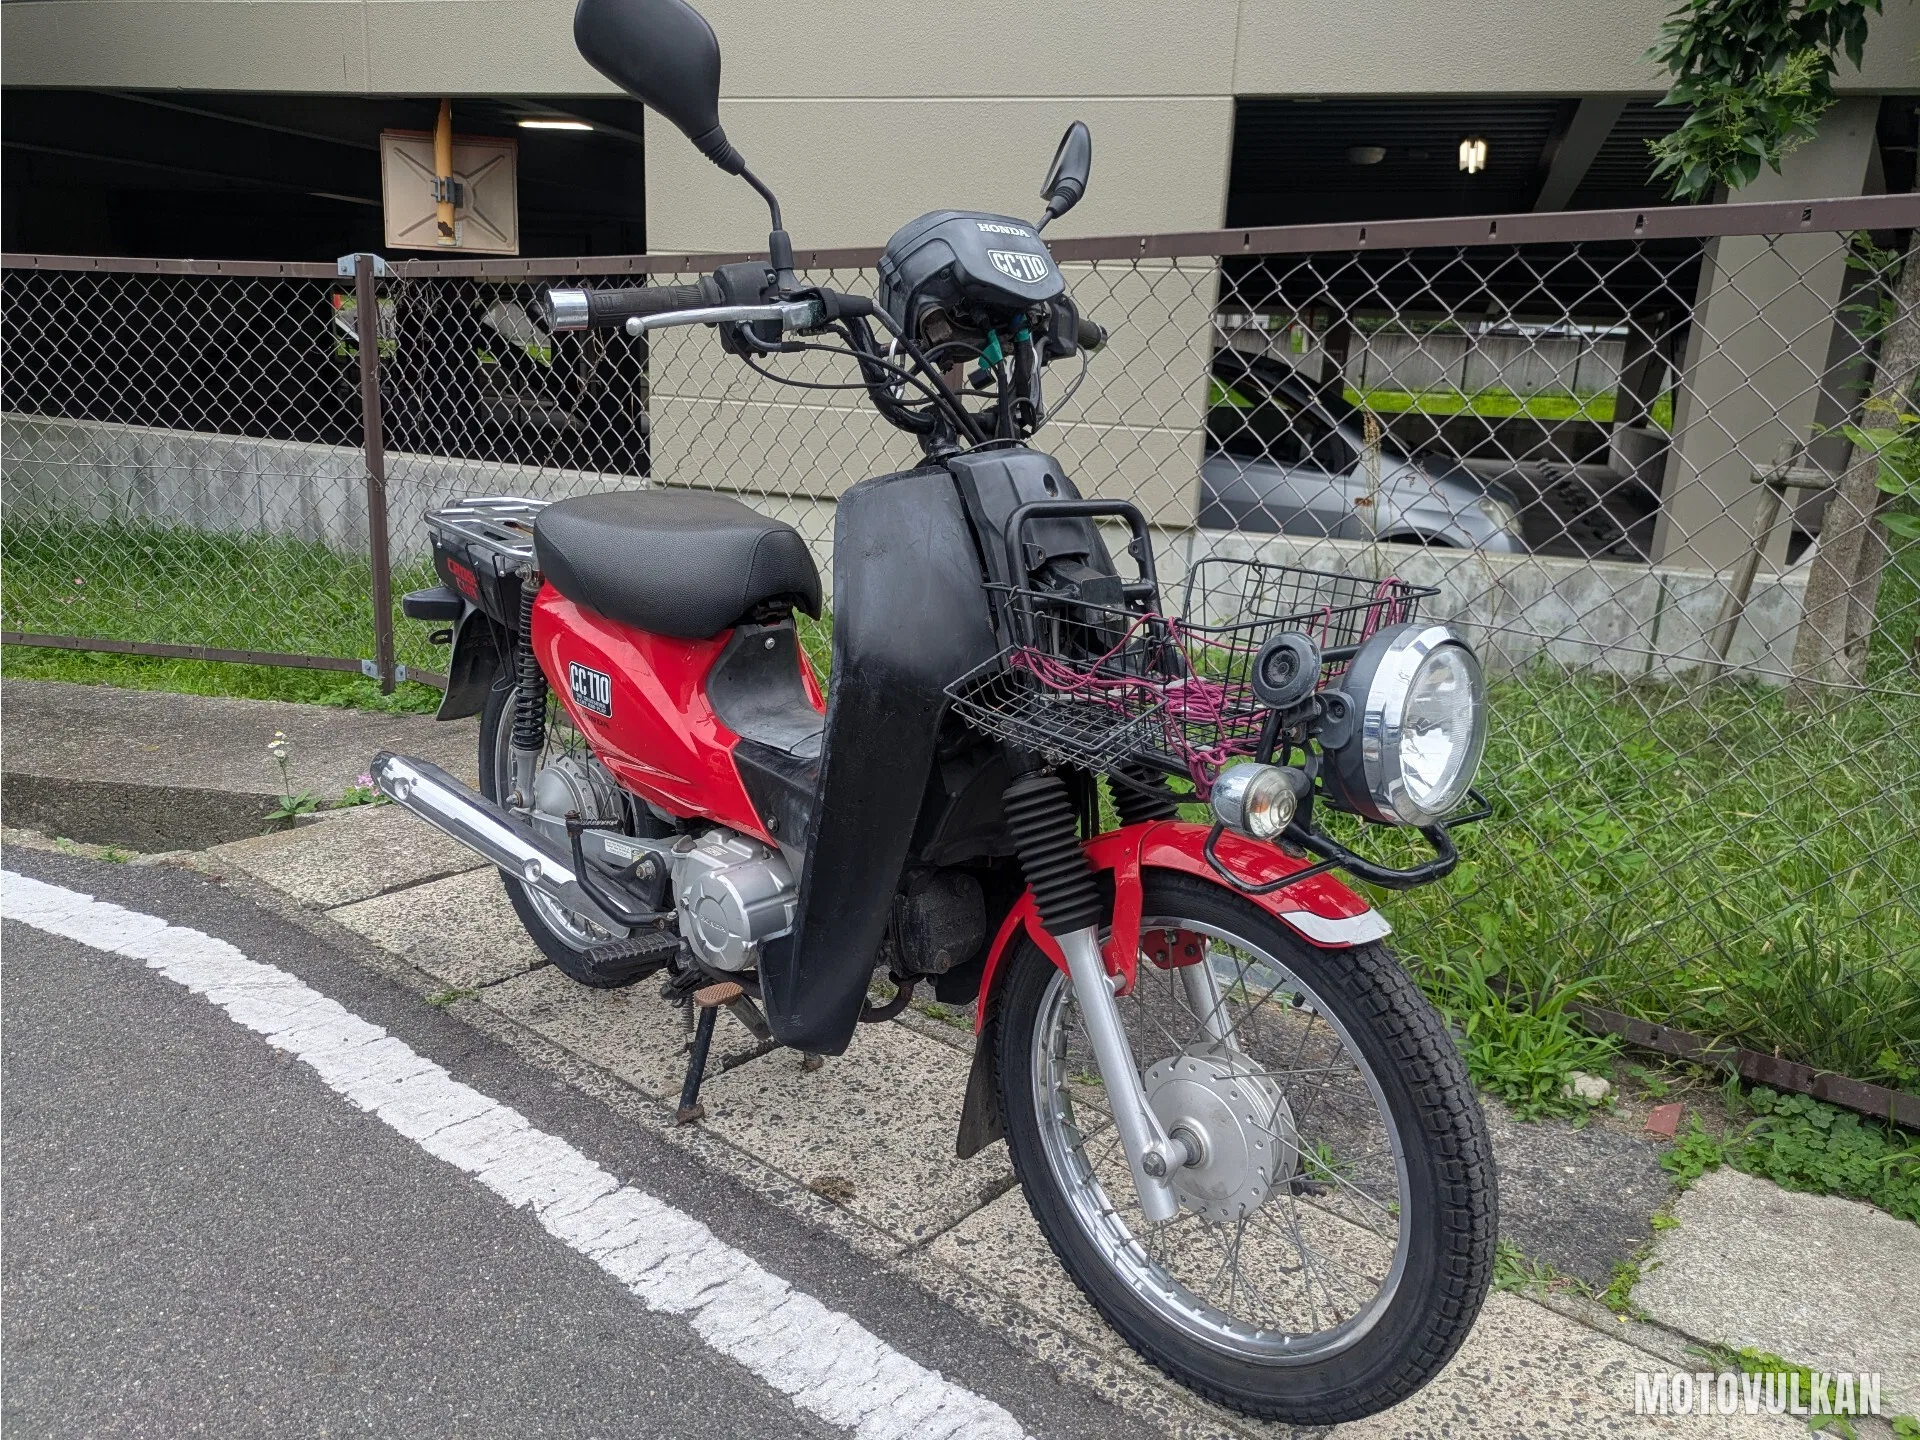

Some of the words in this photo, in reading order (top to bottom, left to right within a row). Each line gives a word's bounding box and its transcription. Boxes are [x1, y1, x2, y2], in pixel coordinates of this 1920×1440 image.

[976, 223, 1031, 238] HONDA
[992, 252, 1046, 280] CC110
[570, 664, 610, 705] CC110
